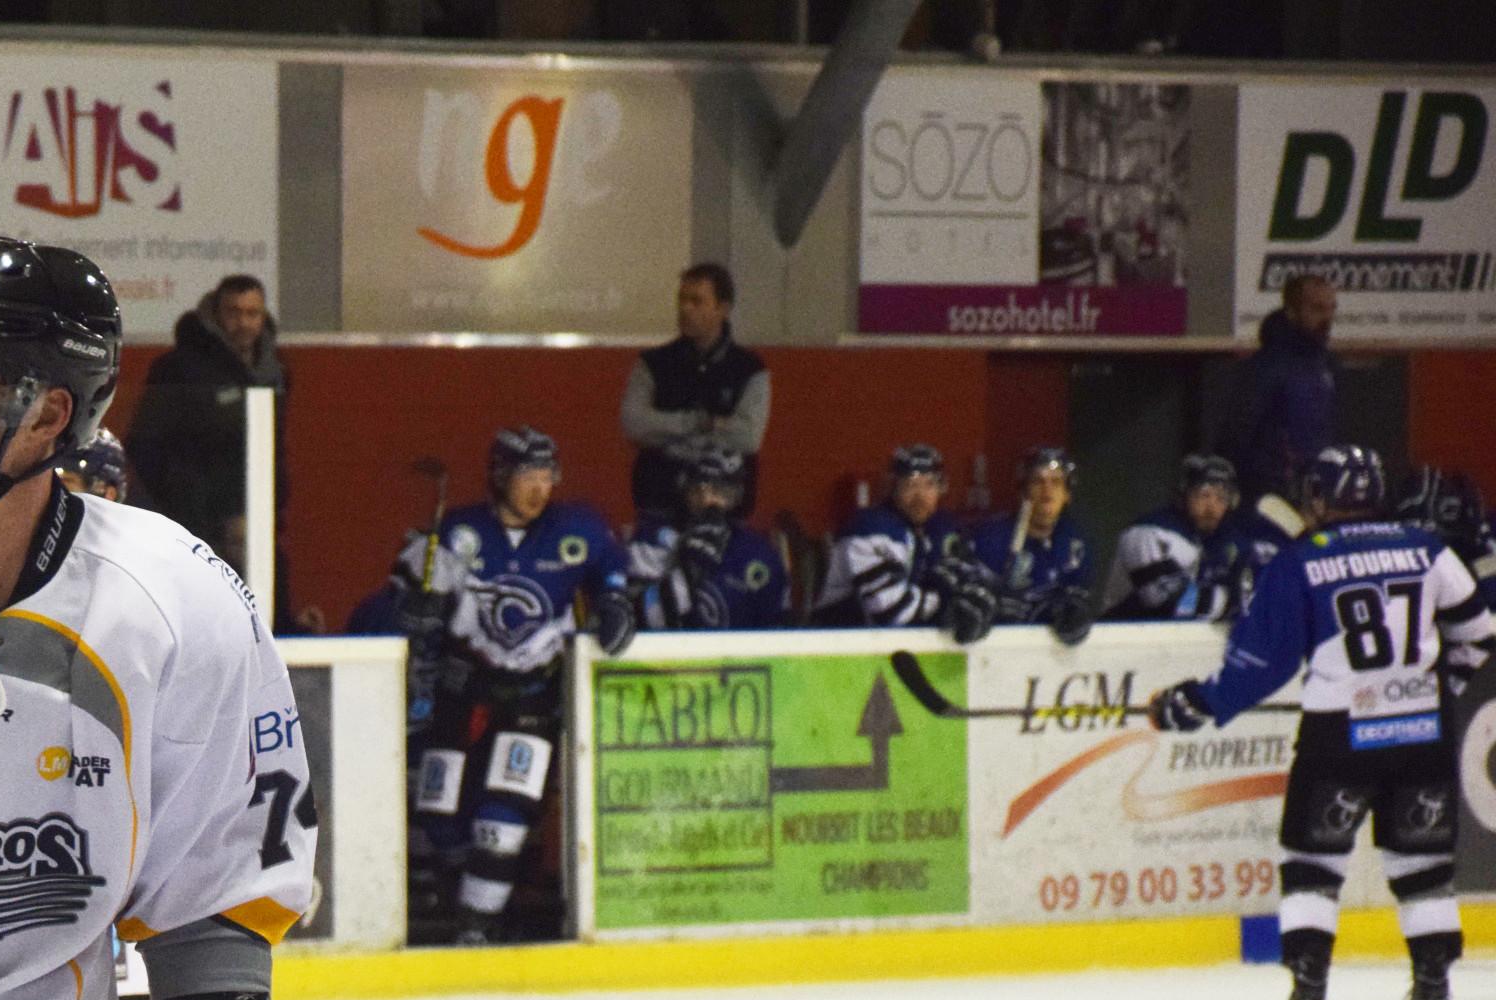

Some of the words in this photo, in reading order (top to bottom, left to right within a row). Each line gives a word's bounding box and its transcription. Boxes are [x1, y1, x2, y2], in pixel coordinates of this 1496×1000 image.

[1268, 90, 1490, 243] DLD
[948, 292, 1102, 333] sozohotel.fr
[61, 338, 108, 359] BAUER
[35, 492, 69, 573] BAUER
[1332, 572, 1426, 672] 87
[1020, 670, 1136, 735] LGM
[1039, 874, 1080, 912] 09
[1090, 870, 1129, 908] 79
[1137, 867, 1178, 904] 00
[1187, 861, 1226, 902] 33
[1235, 857, 1274, 897] 99
